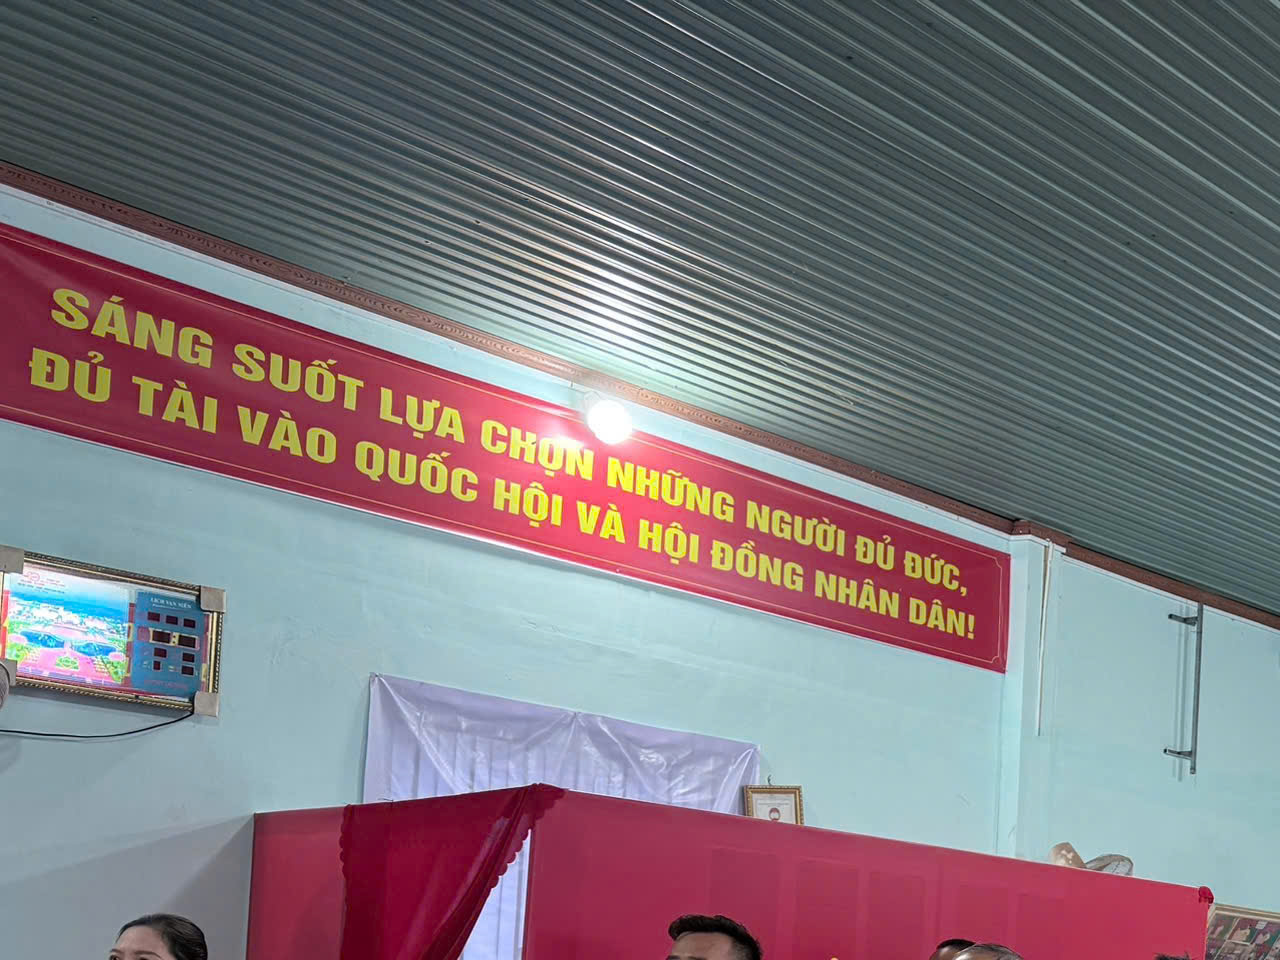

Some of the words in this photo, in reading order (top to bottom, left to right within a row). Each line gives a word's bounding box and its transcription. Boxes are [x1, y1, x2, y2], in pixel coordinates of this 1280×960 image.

[28, 347, 111, 403] ĐỦ
[132, 374, 218, 433] TÀI
[237, 404, 337, 464] VÀO
[354, 440, 479, 502] QUỐC
[493, 480, 563, 529] HỘI
[576, 500, 626, 544] VÀ
[638, 518, 699, 565] HỘI
[710, 539, 804, 593] ĐỒNG
[814, 574, 900, 619] NHÂN
[908, 600, 976, 640] DÂN!
[51, 287, 214, 369] SÁNG
[231, 343, 364, 411] SUỐT
[379, 388, 465, 444] LỰA
[480, 418, 595, 481] CHỌN
[606, 458, 735, 522] NHỮNG
[746, 501, 845, 557] NGƯỜI
[855, 534, 895, 572] ĐỦ
[903, 552, 968, 596] ĐỨC,
